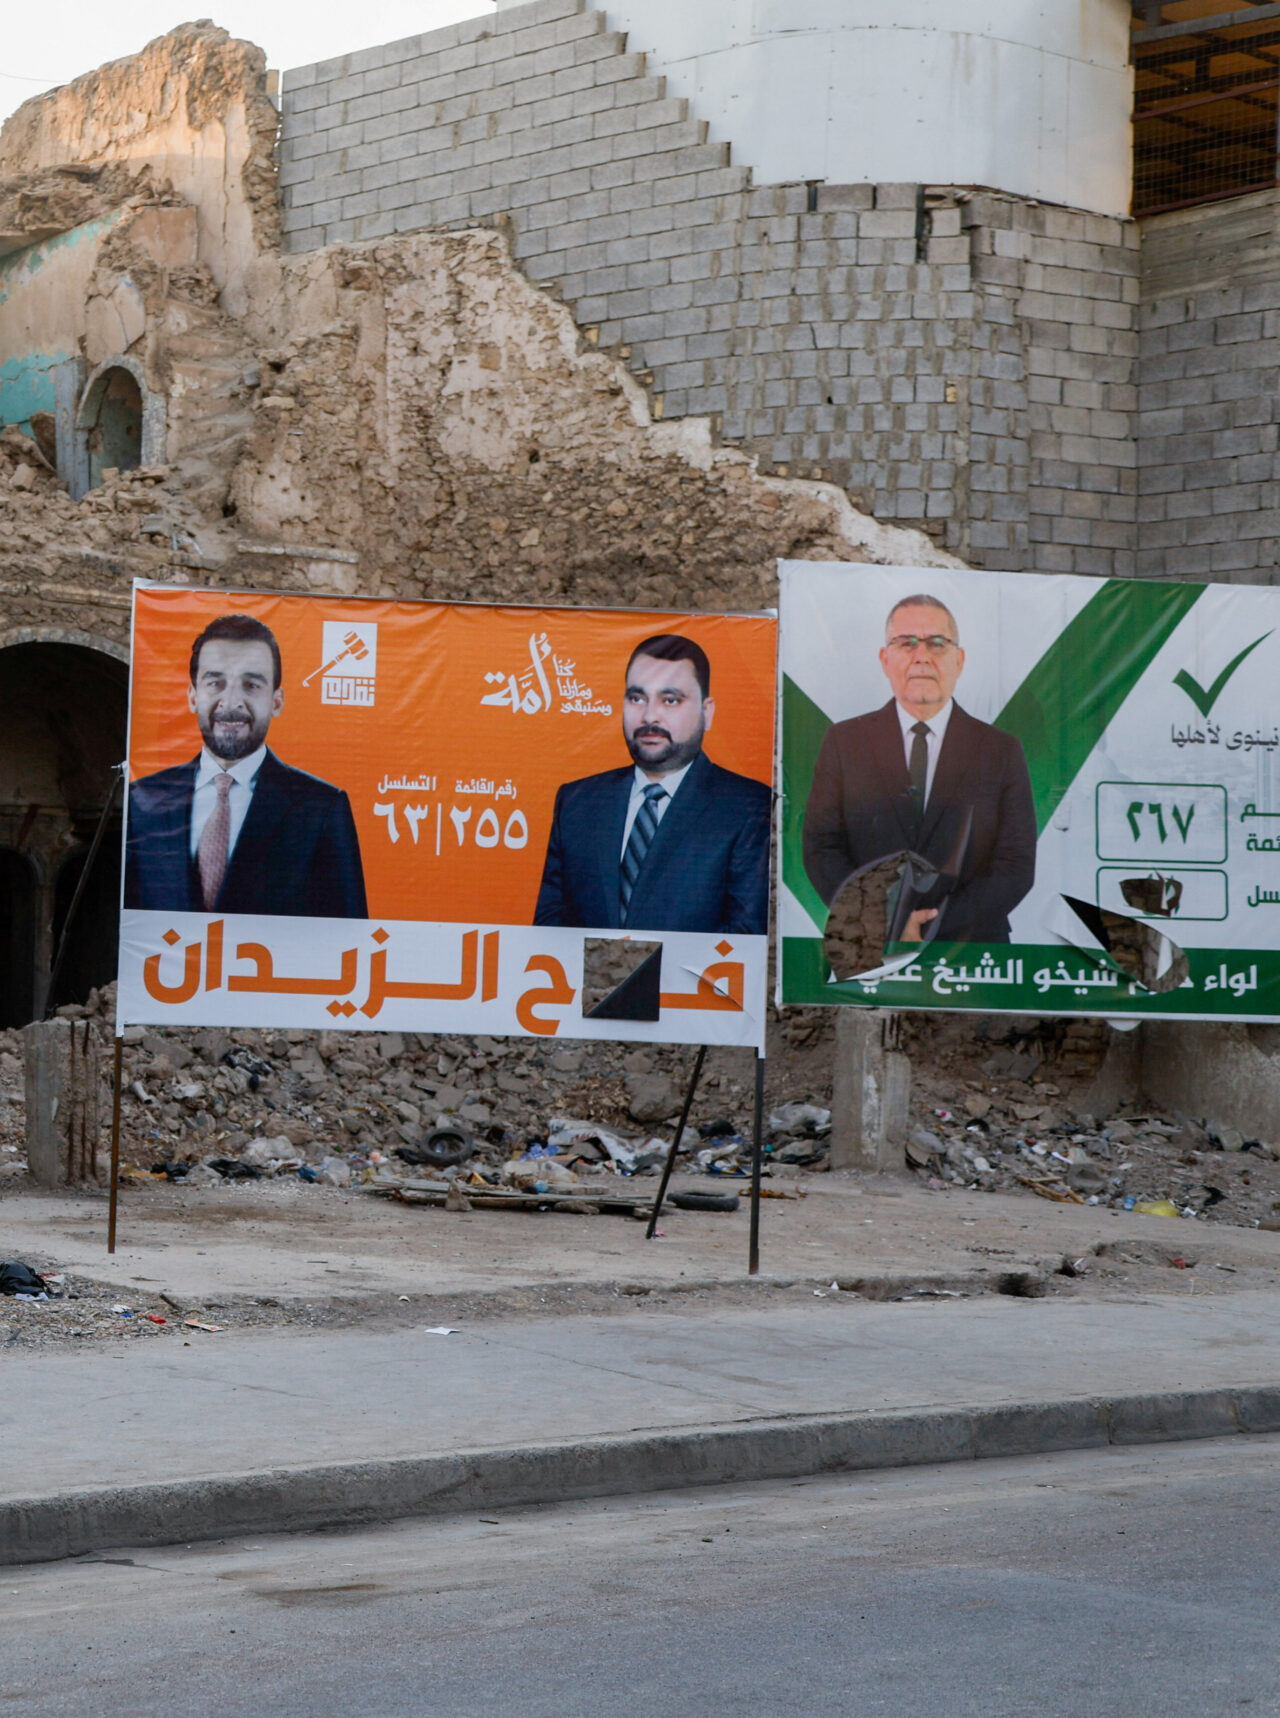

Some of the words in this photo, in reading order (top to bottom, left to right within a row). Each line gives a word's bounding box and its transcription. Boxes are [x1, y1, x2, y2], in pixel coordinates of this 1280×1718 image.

[377, 774, 437, 794] التسلسل
[455, 778, 494, 794] القائمة
[495, 779, 517, 801] رقم
[373, 802, 428, 845] ٦٣
[449, 805, 529, 849] ٢٥٥
[1127, 801, 1195, 845] ٢٦٧
[144, 919, 500, 1019] الزيدان
[932, 952, 1024, 994] الشيخ
[1204, 963, 1258, 997] لواء
